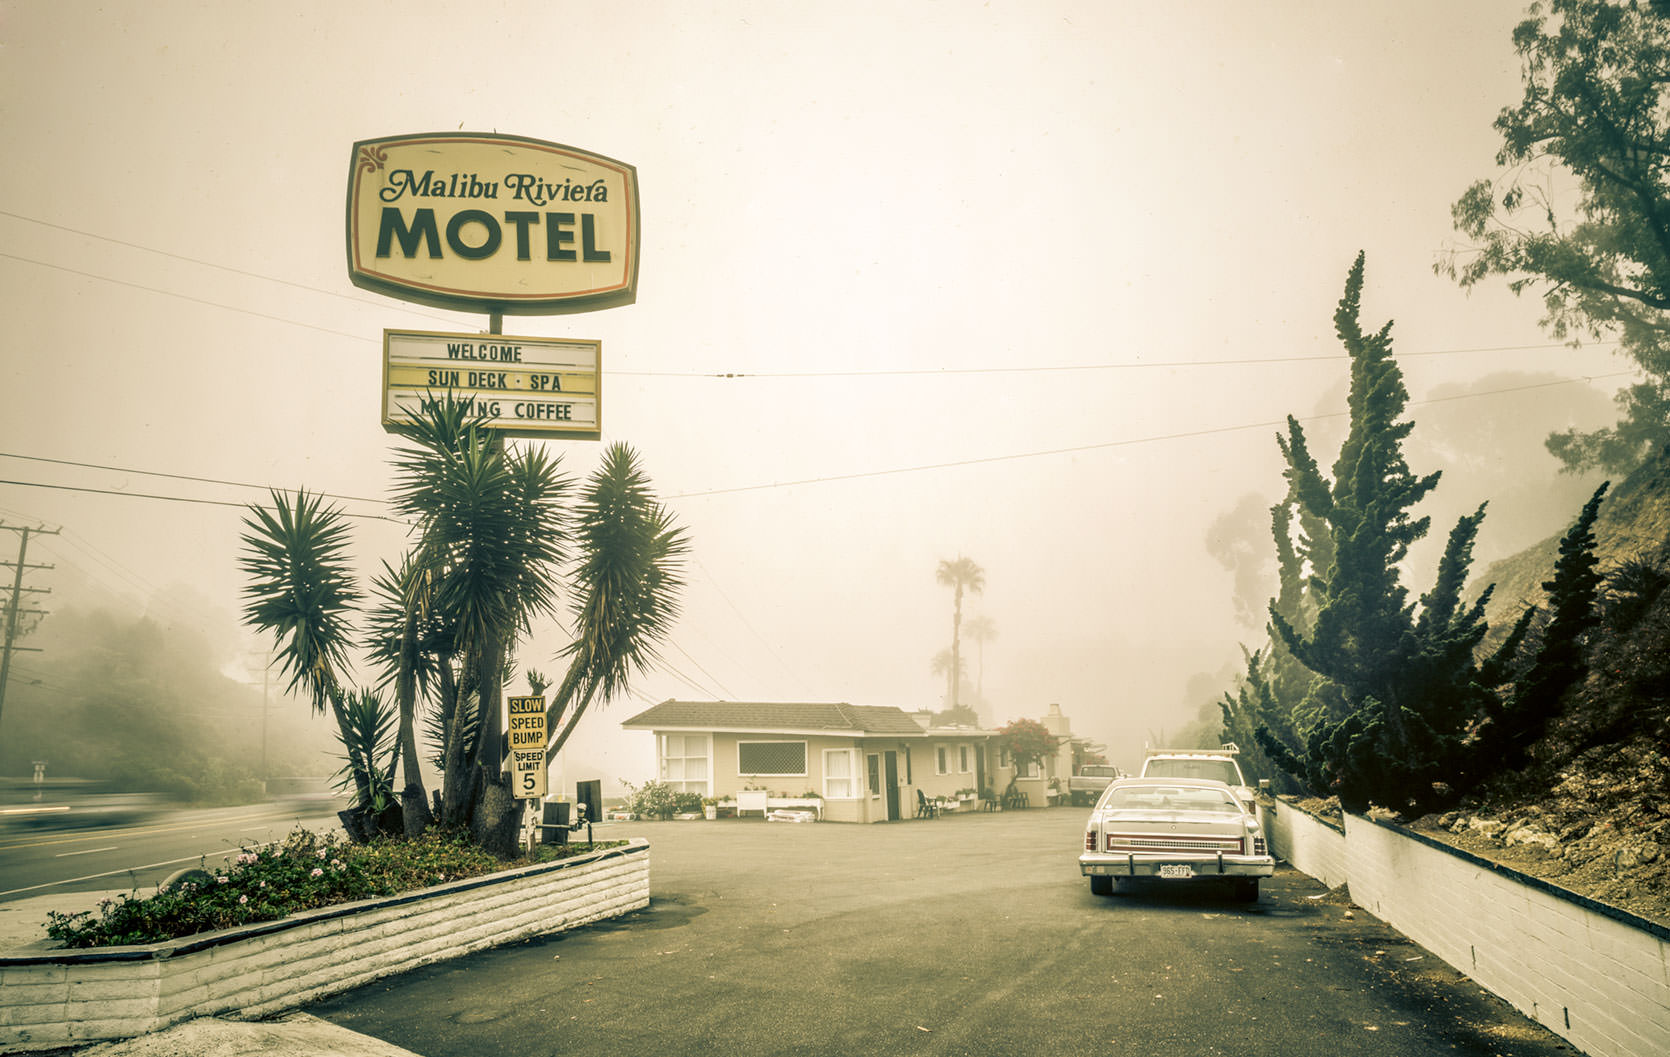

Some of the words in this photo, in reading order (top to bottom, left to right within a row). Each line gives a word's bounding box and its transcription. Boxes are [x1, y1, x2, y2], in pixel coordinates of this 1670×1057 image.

[379, 169, 499, 203] Malibu
[504, 173, 609, 207] Riviera
[376, 207, 611, 263] MOTEL
[447, 343, 522, 362] WELCOME
[428, 370, 459, 387] SUN
[468, 372, 507, 389] DECK
[530, 374, 561, 391] SPA
[421, 399, 501, 417] MING
[514, 402, 572, 420] COFFEE
[511, 699, 542, 713] SLOW
[511, 717, 544, 729] SPEED
[513, 731, 543, 744] BUMP
[515, 752, 543, 762] SPEED
[518, 762, 540, 772] LIMIT
[523, 773, 536, 790] 5
